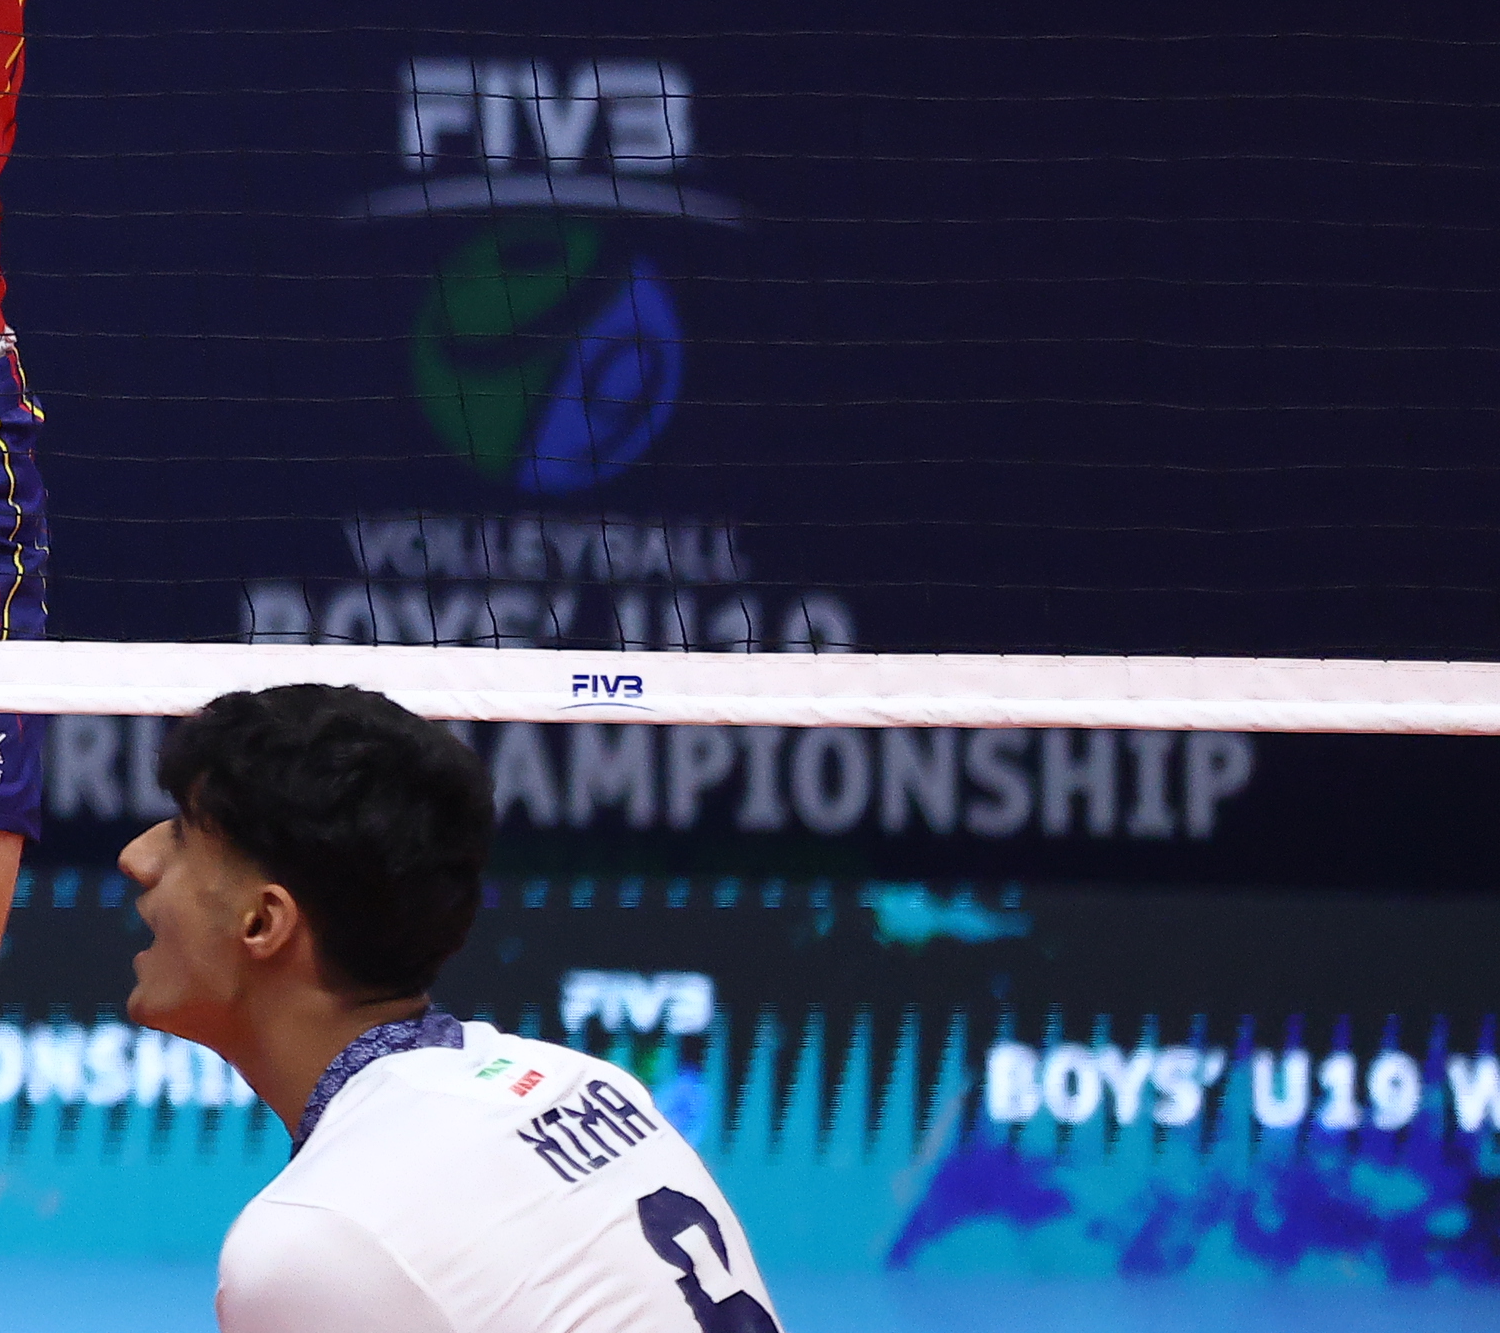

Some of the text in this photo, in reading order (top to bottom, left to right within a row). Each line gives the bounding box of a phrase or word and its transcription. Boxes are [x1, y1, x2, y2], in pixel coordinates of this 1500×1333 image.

[401, 56, 694, 174] FIVB
[342, 513, 750, 585] VOLLEYBALL
[572, 674, 644, 698] FIVB
[452, 721, 1258, 841] AMPIONSHIP
[516, 1079, 658, 1184] NIMA
[984, 1041, 1226, 1127] BOYS'
[1251, 1049, 1423, 1131] U19
